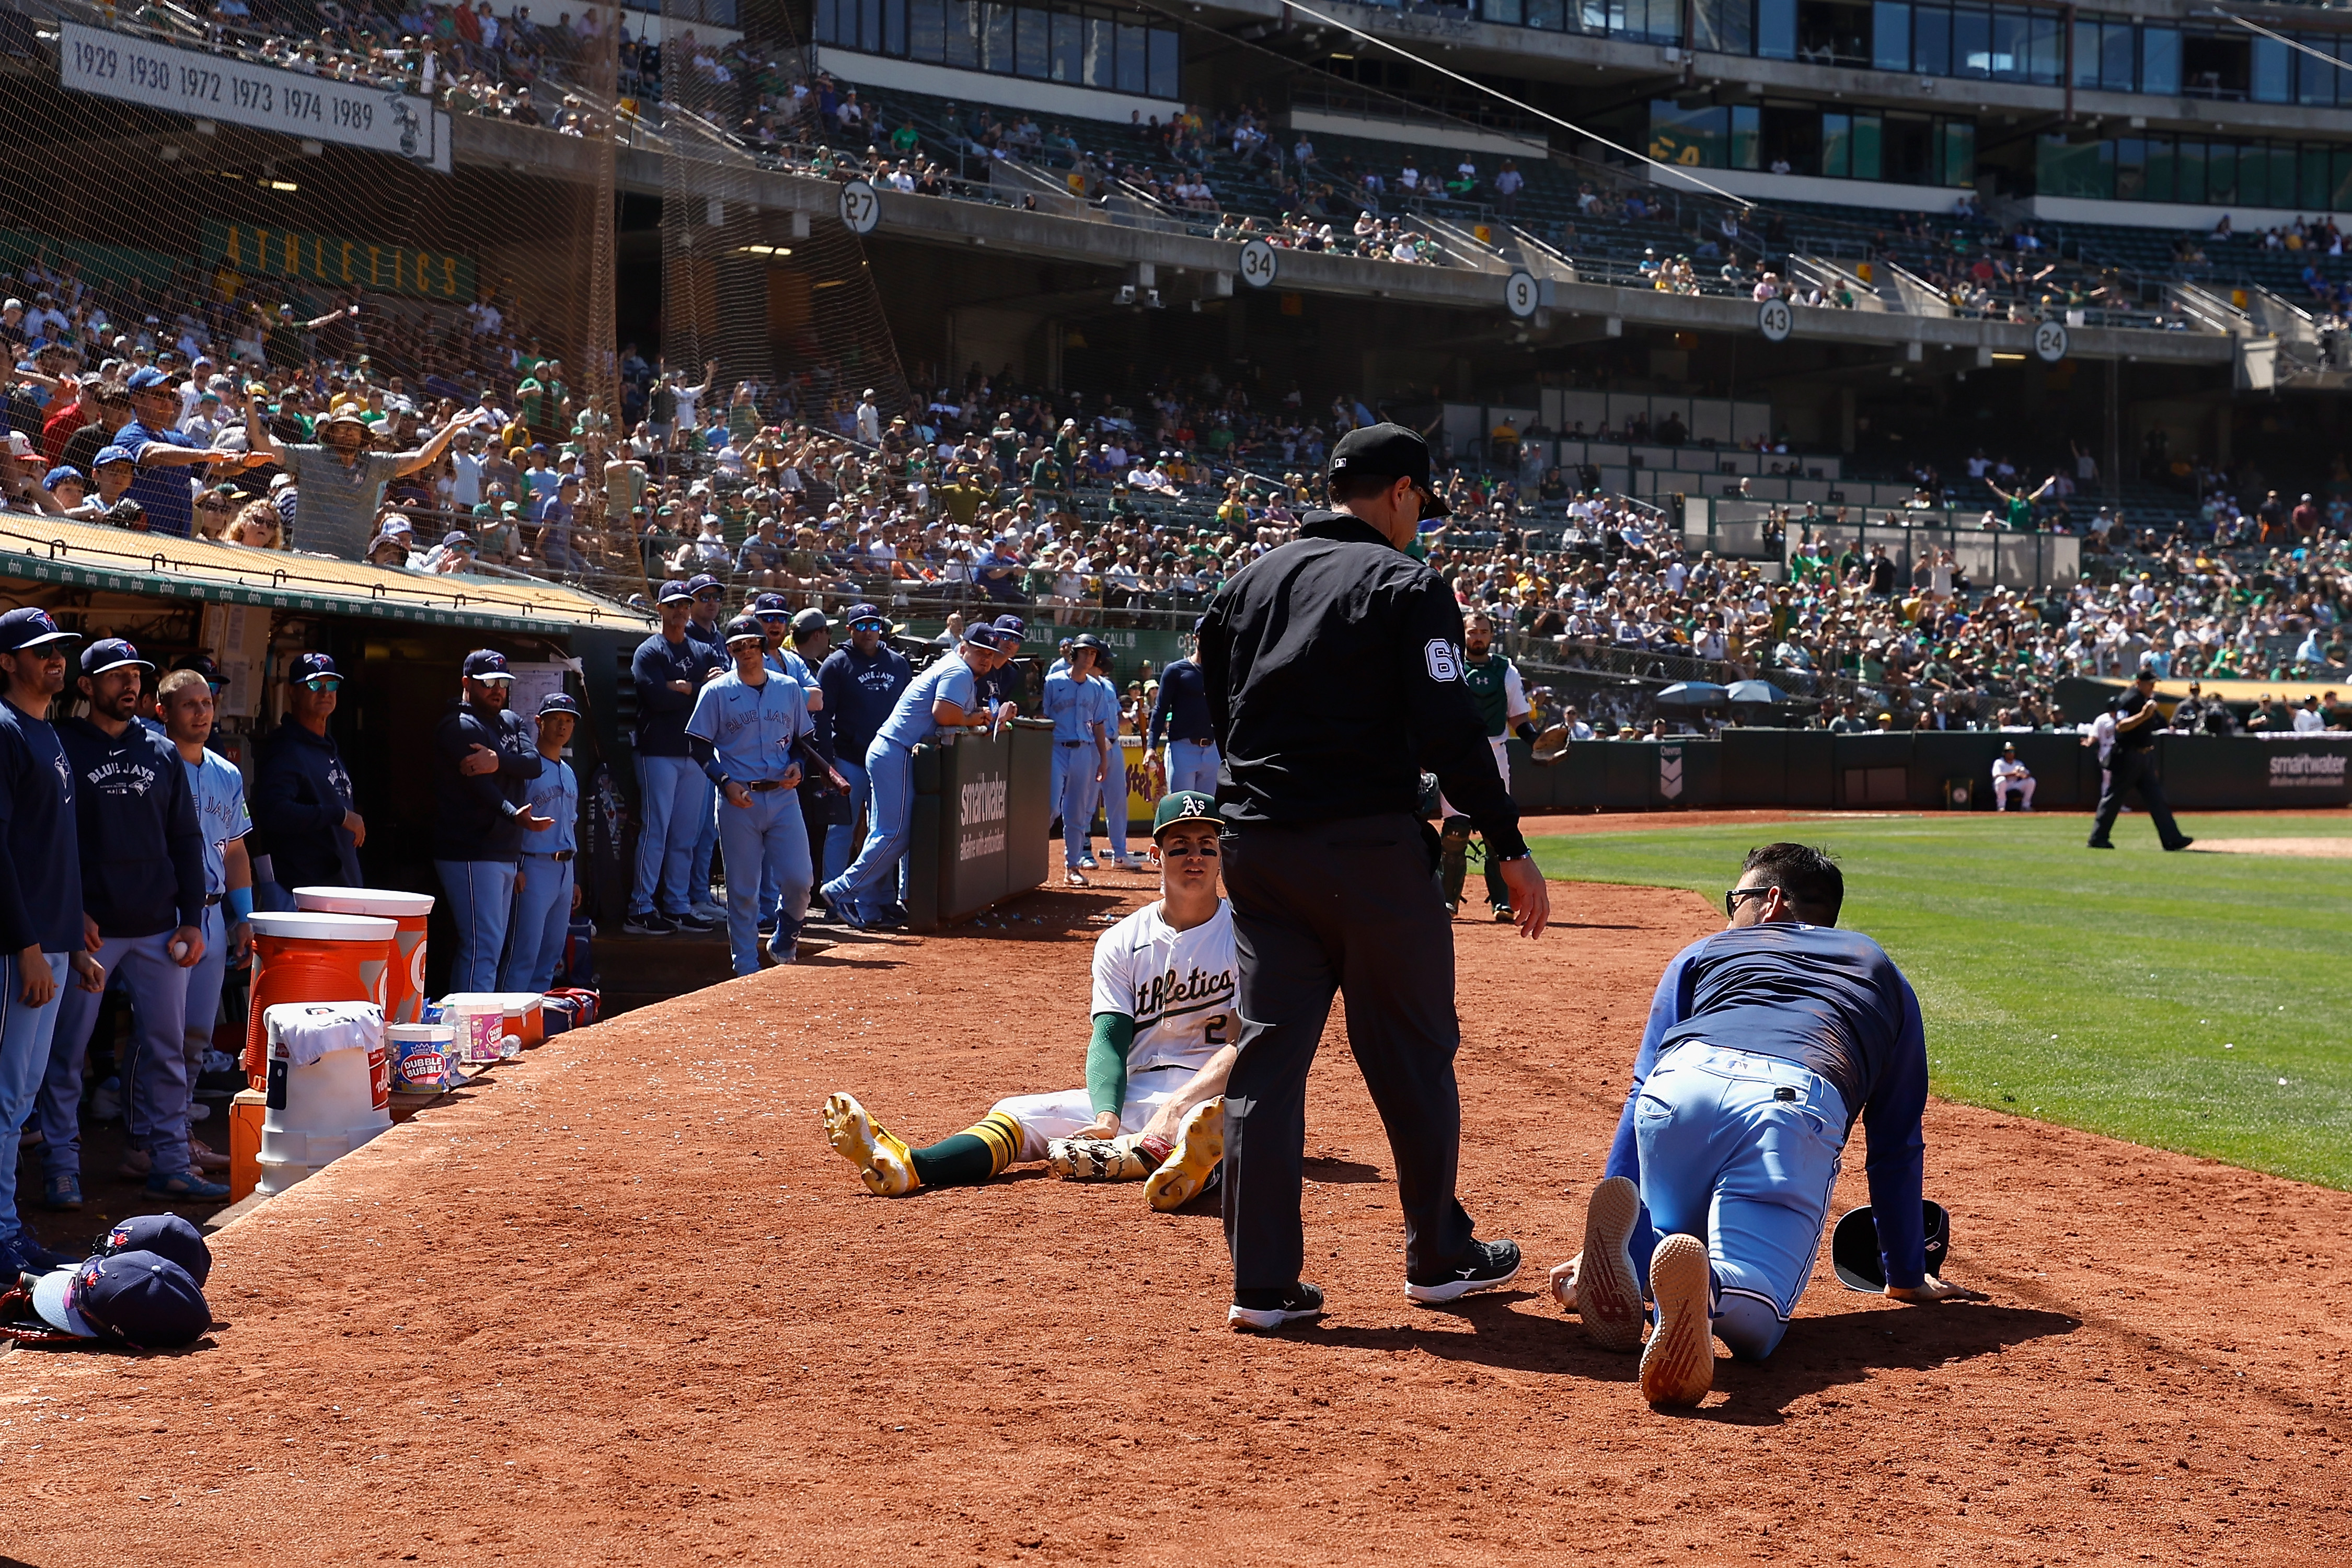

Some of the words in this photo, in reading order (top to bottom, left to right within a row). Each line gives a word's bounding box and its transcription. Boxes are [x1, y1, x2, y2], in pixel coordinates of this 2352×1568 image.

[75, 41, 117, 78] 1929
[130, 54, 170, 90] 1930
[180, 66, 221, 102] 1972
[233, 76, 272, 111] 1973
[284, 87, 322, 121] 1974
[333, 98, 373, 131] 1989
[226, 226, 457, 295] ATHLETICS
[1247, 250, 1271, 278] 34
[1517, 282, 1527, 307] 9
[1765, 308, 1786, 331] 43
[2040, 330, 2061, 352] 24
[1023, 628, 1043, 642] CALL
[1103, 632, 1125, 646] CALL
[858, 671, 875, 683] BLUE
[876, 672, 895, 682] JAYS
[726, 710, 758, 735] BLUE
[764, 709, 791, 729] JAYS
[123, 763, 155, 781] JAYS
[961, 771, 1007, 826] smartwater
[1179, 794, 1205, 817] A's
[1135, 966, 1235, 1017] thletics
[404, 1056, 442, 1070] DUBBLE
[406, 1065, 444, 1078] BUBBLE
